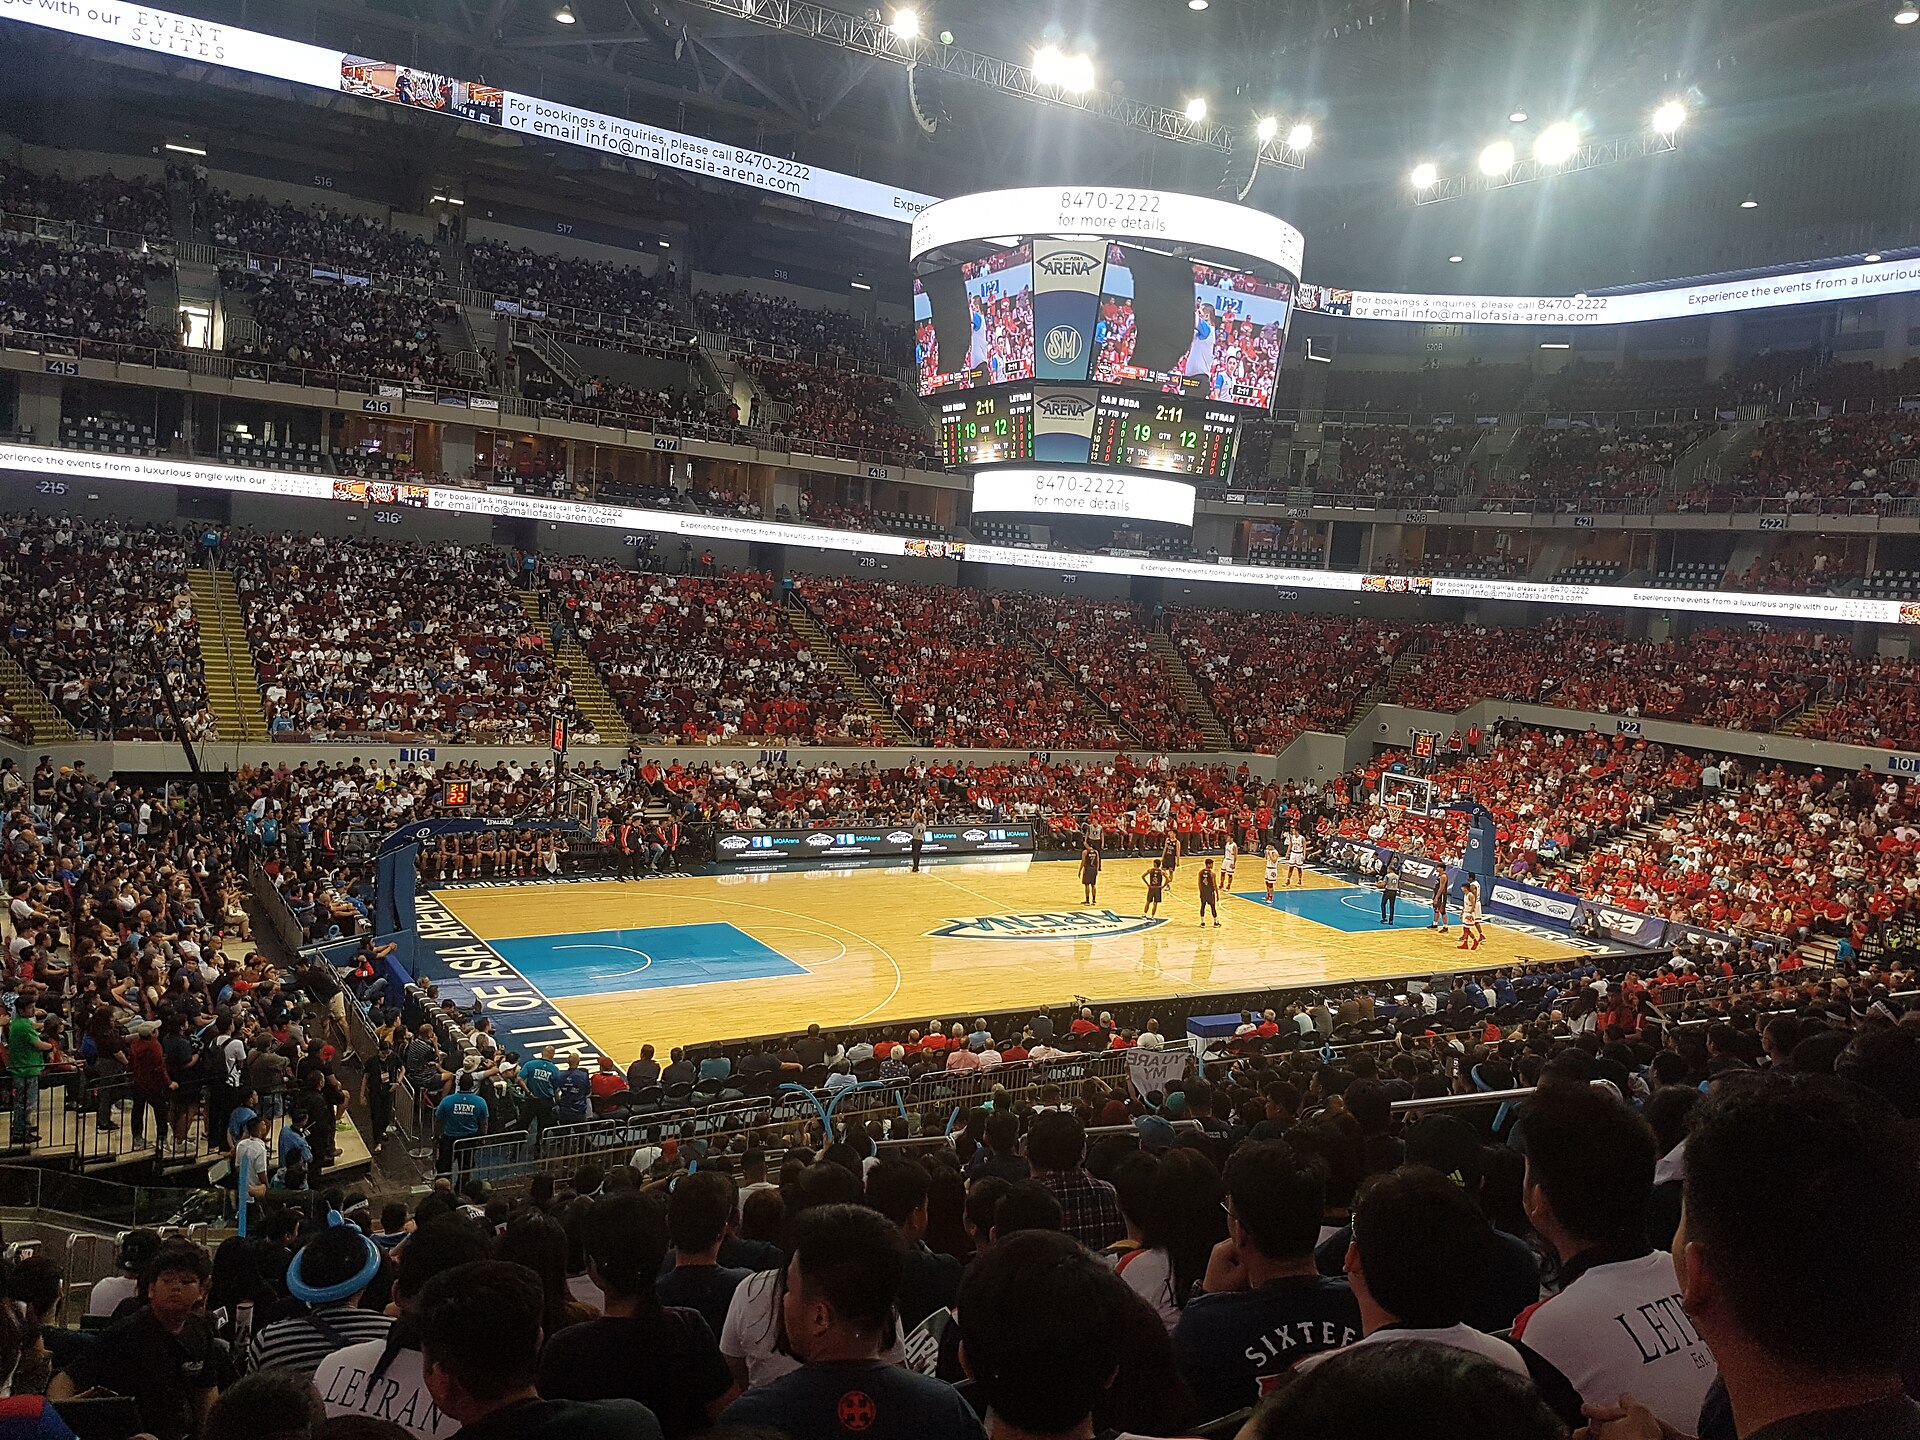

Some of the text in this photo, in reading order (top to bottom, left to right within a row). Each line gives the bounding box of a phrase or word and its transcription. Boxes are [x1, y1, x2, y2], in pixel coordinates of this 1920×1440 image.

[40, 0, 121, 26] with our
[138, 12, 222, 42] EVENT
[131, 28, 224, 60] SUITES
[510, 98, 810, 181] For bookings & inquiries, please call 8470-2222
[509, 114, 800, 194] or email info@mallofasia-arena.com
[314, 176, 334, 188] 516
[893, 196, 928, 212] Exper
[1061, 192, 1160, 213] 8470-2222
[556, 222, 573, 234] 517
[1058, 212, 1166, 232] for more details
[772, 269, 788, 280] 518
[1044, 261, 1090, 276] ARENA
[1688, 269, 1920, 306] Experience the events from a luxurious
[1356, 295, 1372, 304] For
[1375, 296, 1420, 307] bookings
[1482, 300, 1513, 310] please
[1517, 301, 1535, 309] call
[1538, 299, 1608, 311] 8470-2222
[1356, 306, 1598, 322] or email info@mallofasia-arena.com
[1048, 330, 1076, 359] SM
[49, 361, 76, 375] 415
[366, 401, 388, 412] 416
[976, 398, 994, 416] 2:11
[1100, 394, 1118, 406] SAN
[1042, 402, 1084, 416] ARENA
[1155, 404, 1183, 423] 2:11
[964, 422, 977, 439] 19
[994, 418, 1007, 436] 12
[1133, 424, 1151, 442] 19
[656, 439, 675, 450] 417
[1180, 430, 1197, 448] 12
[46, 456, 64, 466] the
[66, 459, 102, 469] events
[104, 461, 130, 472] from
[143, 466, 192, 478] luxurious
[194, 470, 222, 482] angle
[224, 472, 246, 483] with
[249, 477, 266, 485] our
[870, 468, 886, 478] 418
[40, 481, 66, 494] 215
[1036, 475, 1125, 495] 8470-2222
[450, 493, 486, 504] bookings
[532, 503, 556, 512] please
[558, 504, 572, 512] call
[574, 504, 623, 518] 8470-2222
[1034, 494, 1130, 512] for more details
[378, 511, 399, 524] 216
[434, 500, 616, 525] or email info@mallofasia-arena.com
[1406, 514, 1426, 523] 420B
[680, 520, 720, 532] Experience
[721, 524, 733, 532] the
[735, 526, 757, 535] events
[758, 527, 776, 537] from
[1576, 517, 1593, 526] 421
[1761, 519, 1783, 529] 422
[626, 536, 644, 546] 217
[860, 558, 875, 567] 218
[1063, 574, 1076, 583] 219
[1446, 588, 1470, 596] email
[1448, 581, 1478, 590] bookings
[1550, 586, 1590, 595] 8470-2222
[1280, 591, 1298, 600] 220
[1633, 594, 1672, 603] Experience
[1672, 595, 1686, 603] the
[1686, 597, 1710, 605] events
[1712, 597, 1731, 606] from
[1740, 600, 1777, 608] luxurious
[1778, 601, 1802, 611] angle
[1802, 603, 1822, 612] with
[1618, 722, 1638, 733] 122
[1419, 736, 1433, 744] 2:11
[405, 749, 430, 761] 116
[765, 750, 783, 762] 117
[1416, 742, 1430, 756] 22
[1893, 758, 1918, 770] 101
[451, 784, 468, 792] 2:11
[1460, 784, 1468, 792] 22
[450, 792, 464, 803] 22
[486, 818, 514, 826] SPALDING
[946, 909, 1124, 932] ARENA
[435, 944, 518, 980] ASIA
[470, 986, 543, 1011] OF
[534, 1068, 552, 1079] EVENT
[454, 1104, 476, 1112] EVENT
[323, 1366, 443, 1435] LETRAN
